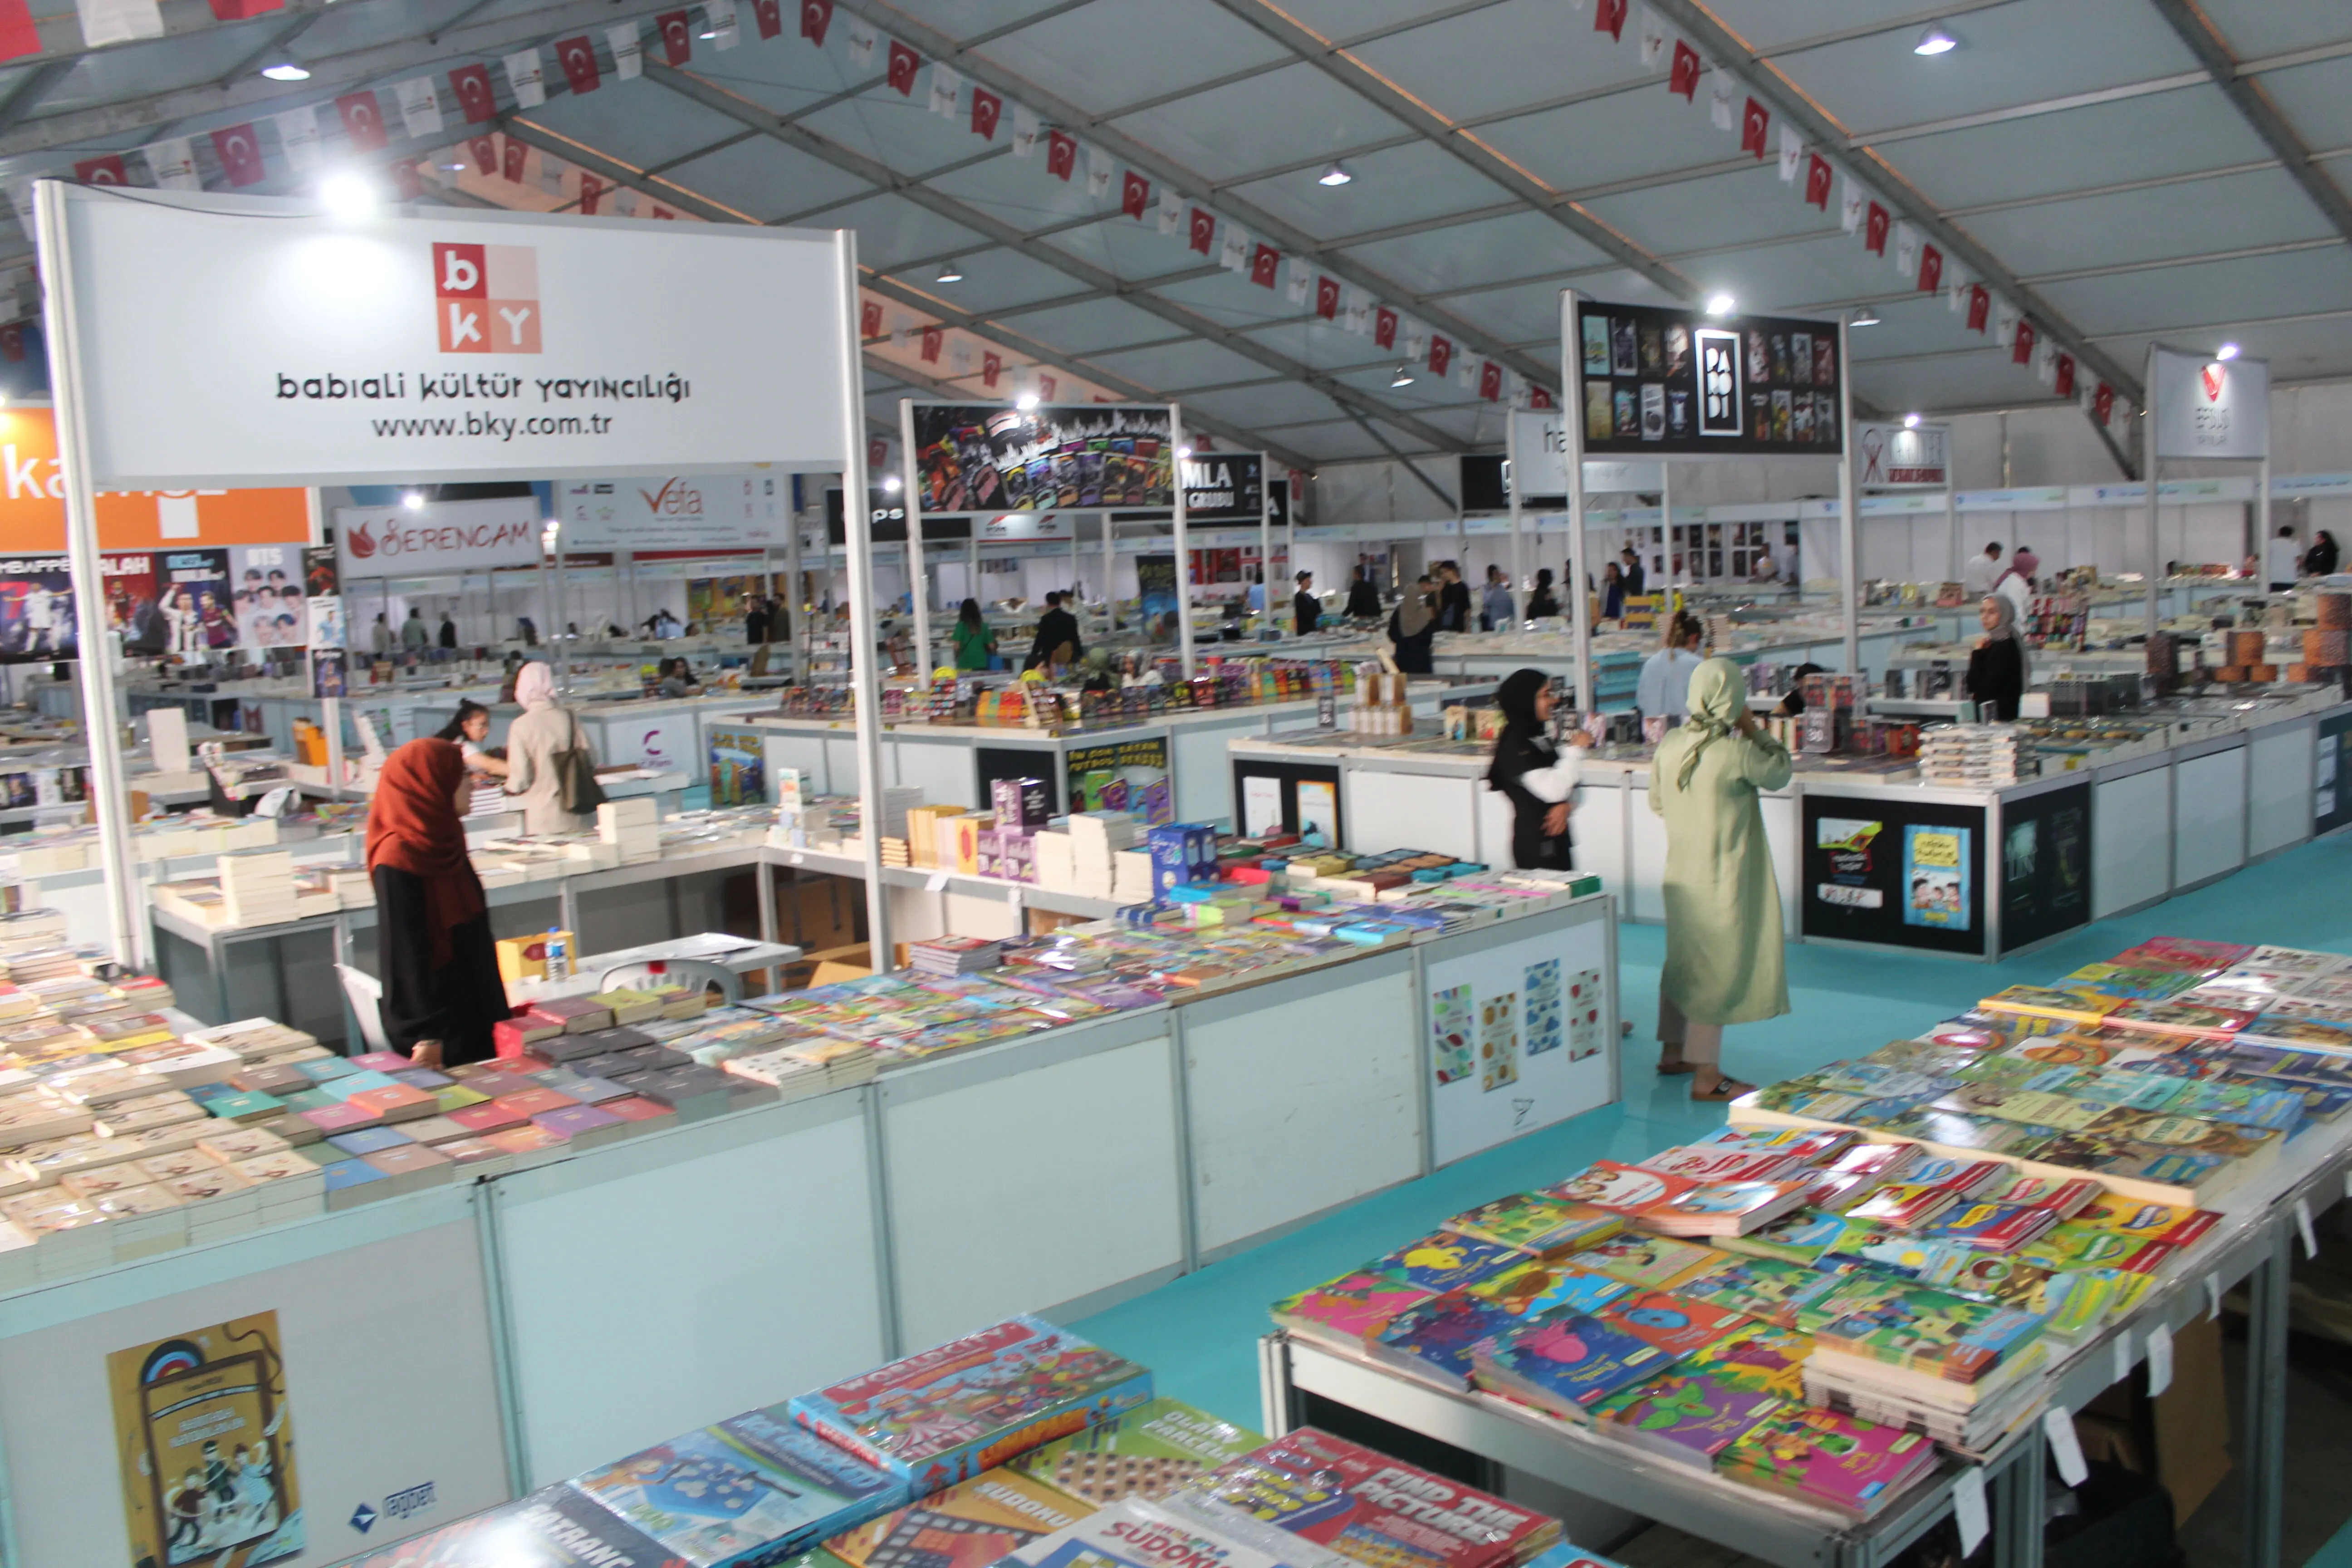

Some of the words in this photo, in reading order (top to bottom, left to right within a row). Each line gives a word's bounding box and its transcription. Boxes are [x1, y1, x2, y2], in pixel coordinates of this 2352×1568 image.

[444, 250, 479, 291] b
[419, 372, 523, 402] kültür
[371, 411, 613, 441] www.bky.com.tr
[1180, 461, 1234, 489] MLA
[99, 556, 150, 576] ALAH
[245, 548, 283, 566] BTS
[1350, 1480, 1512, 1546] PICTURES
[1371, 1467, 1455, 1503] FIND
[1455, 1496, 1531, 1533] THE
